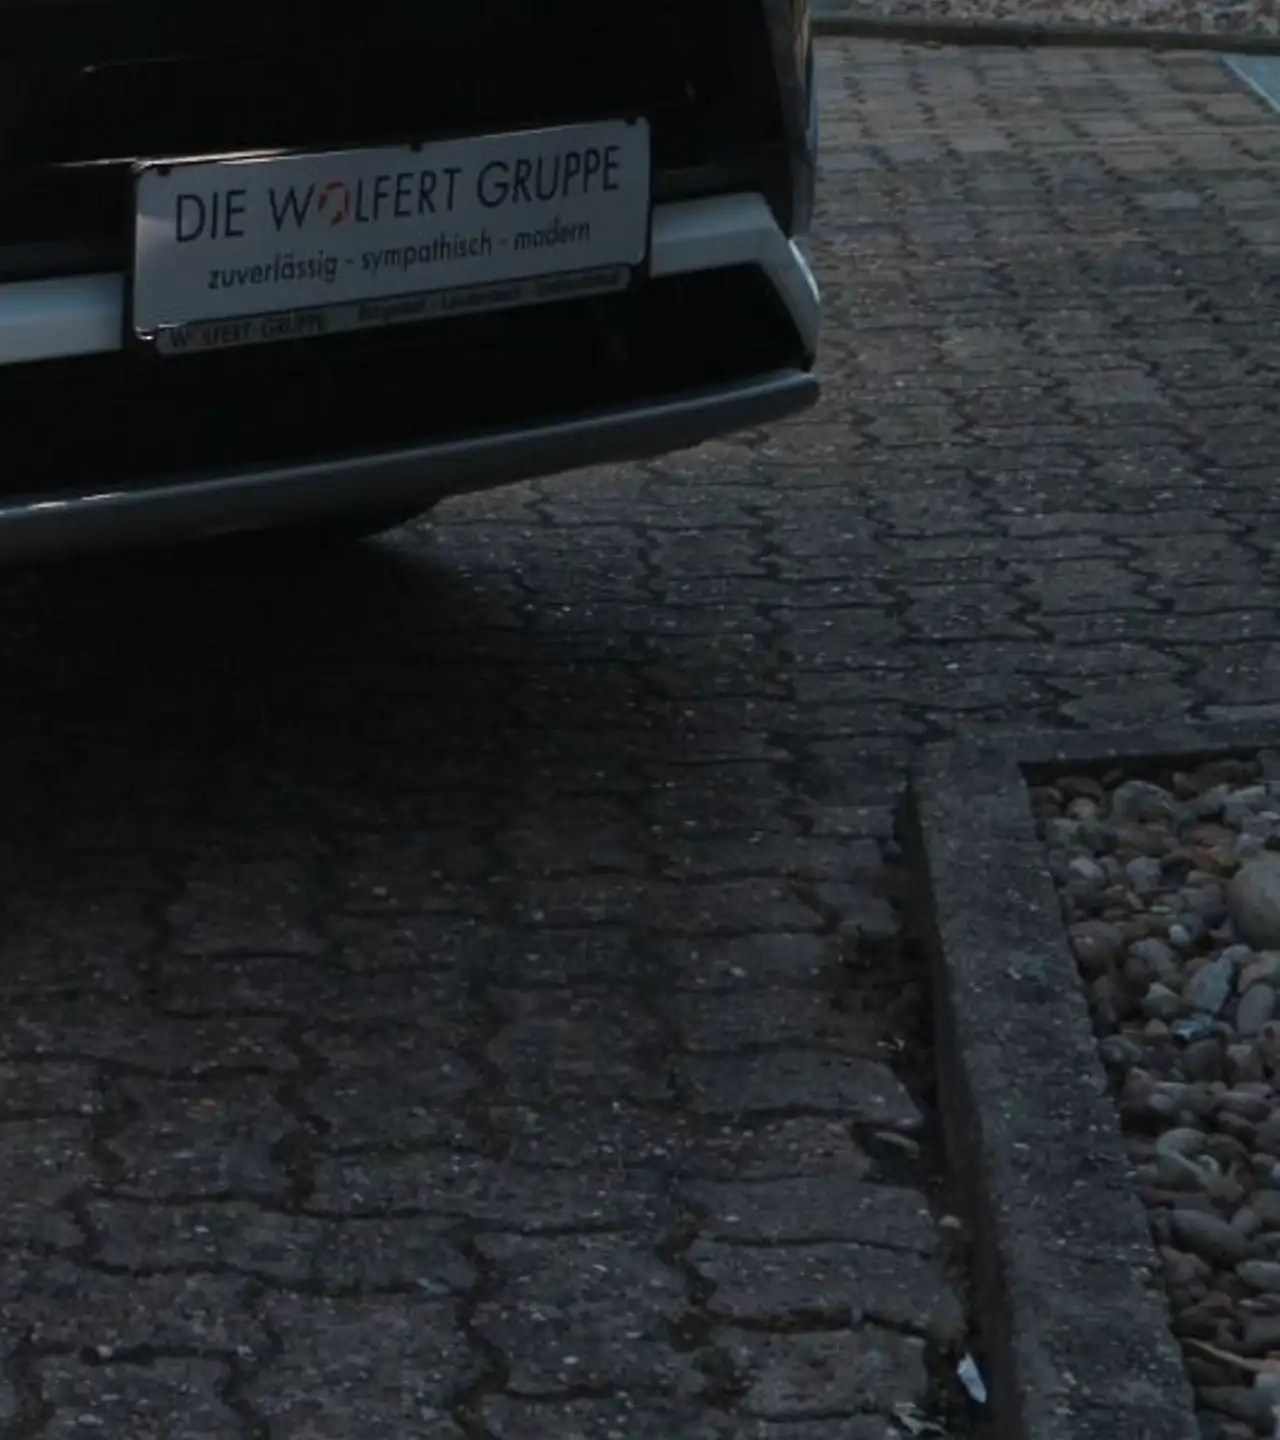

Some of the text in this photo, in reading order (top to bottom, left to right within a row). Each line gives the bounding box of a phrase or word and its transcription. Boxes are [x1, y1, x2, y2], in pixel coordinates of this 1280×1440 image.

[175, 145, 621, 243] DIE WOLFERT GRUPPE
[207, 251, 339, 291] zuverlässig
[361, 227, 493, 272] sympathisch
[513, 220, 591, 252] modern
